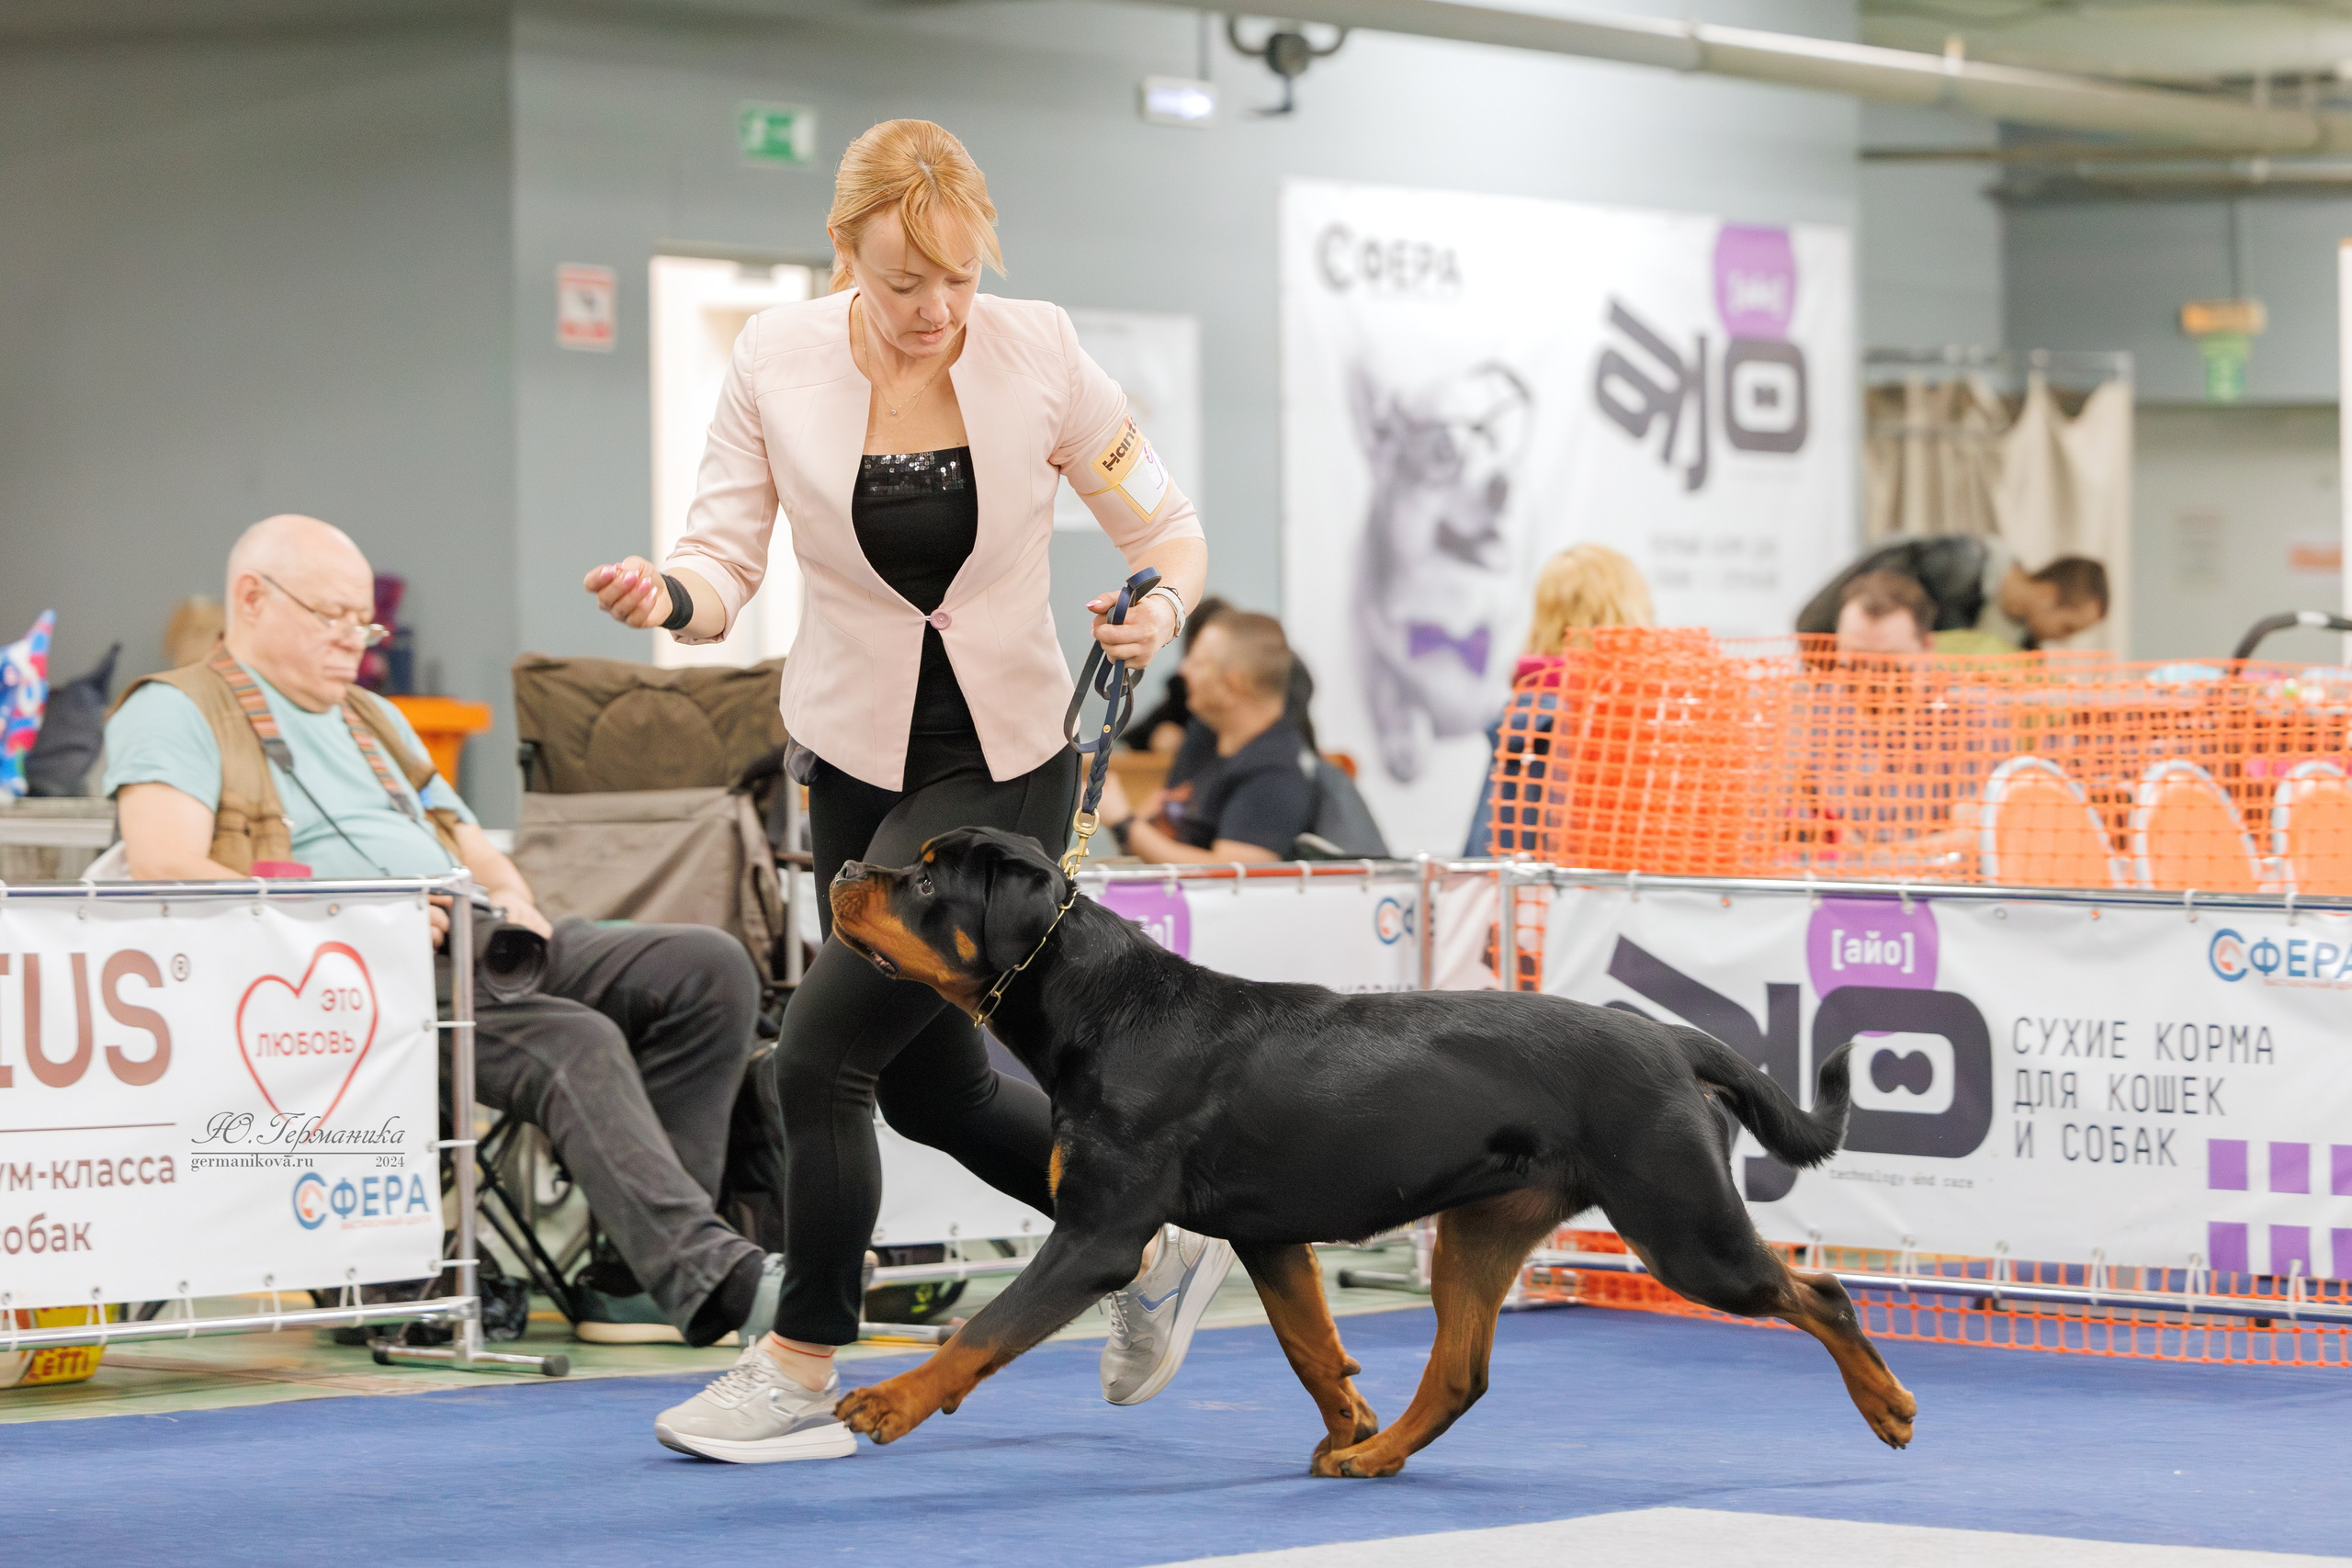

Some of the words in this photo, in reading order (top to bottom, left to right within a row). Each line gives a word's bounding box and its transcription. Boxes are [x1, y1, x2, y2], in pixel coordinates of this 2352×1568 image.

[1831, 928, 1915, 974] [айо]
[321, 987, 363, 1011] ЭТО
[256, 1031, 356, 1057] ЛЮБОВЬ
[2012, 1016, 2127, 1058] СУХИЕ
[2155, 1022, 2275, 1065] КОРМА
[2012, 1068, 2077, 1114] ДЛЯ
[2109, 1073, 2225, 1116] КОШЕК
[2015, 1121, 2033, 1158] И
[2062, 1123, 2177, 1167] СОБАК
[0, 1155, 176, 1191] м-класса
[292, 1171, 430, 1230] СФЕРА
[0, 1212, 93, 1255] обак
